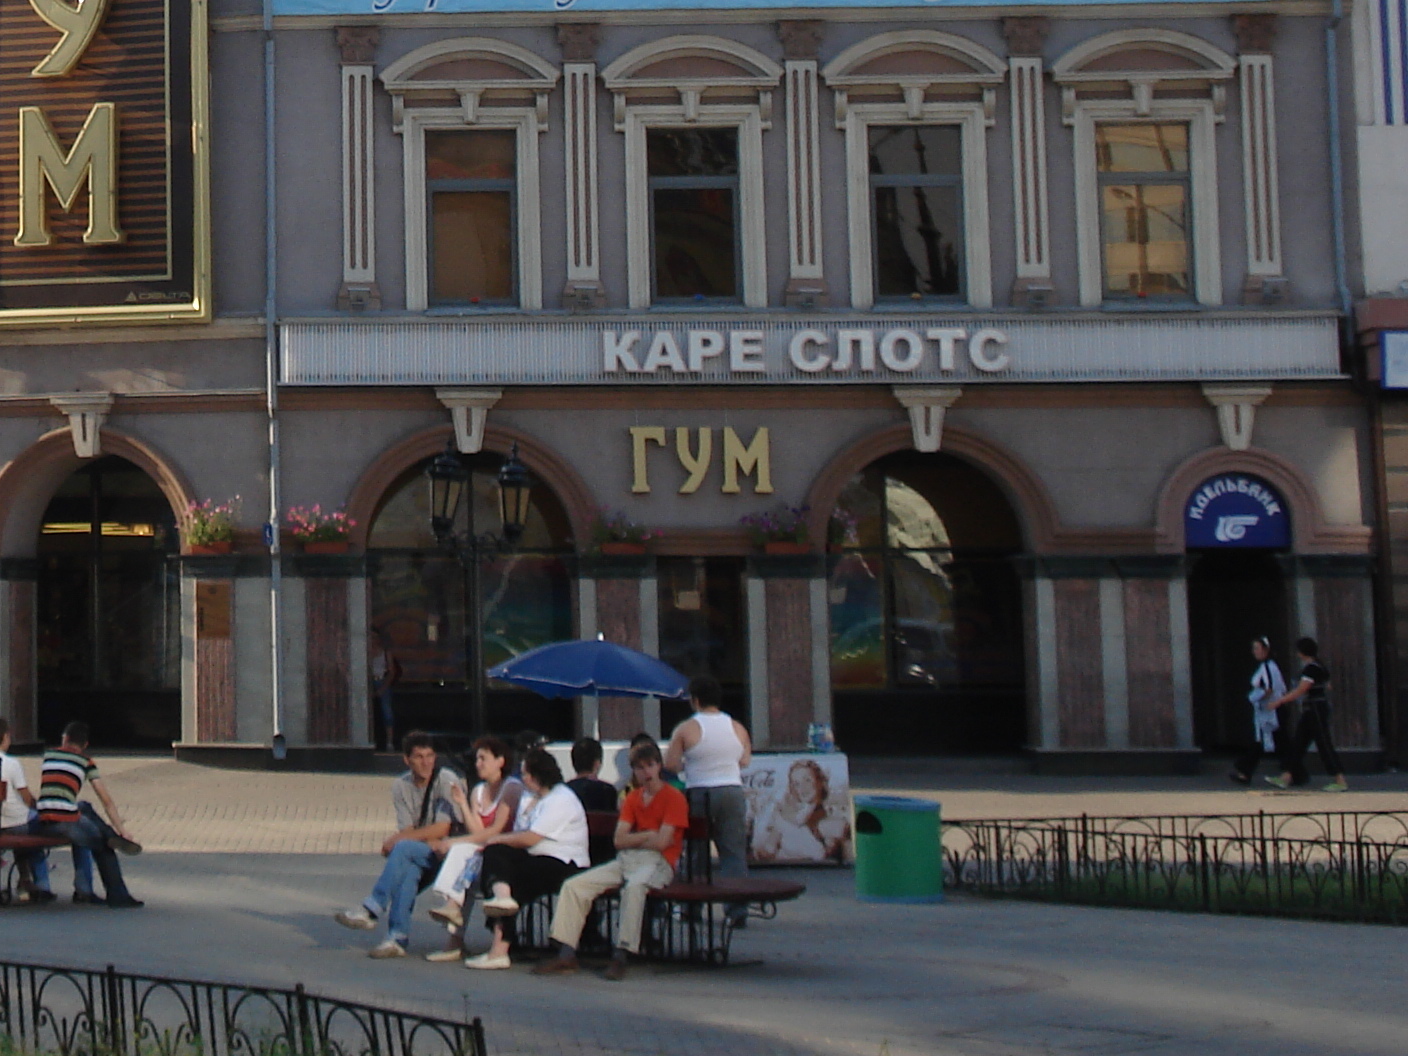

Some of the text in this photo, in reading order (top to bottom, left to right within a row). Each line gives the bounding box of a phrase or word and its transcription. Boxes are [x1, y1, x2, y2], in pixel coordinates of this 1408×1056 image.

[602, 328, 1011, 373] КАРЕ СЛОТС
[629, 426, 774, 494] ГУМ
[1189, 477, 1282, 521] ИДЕЛЬБАНК
